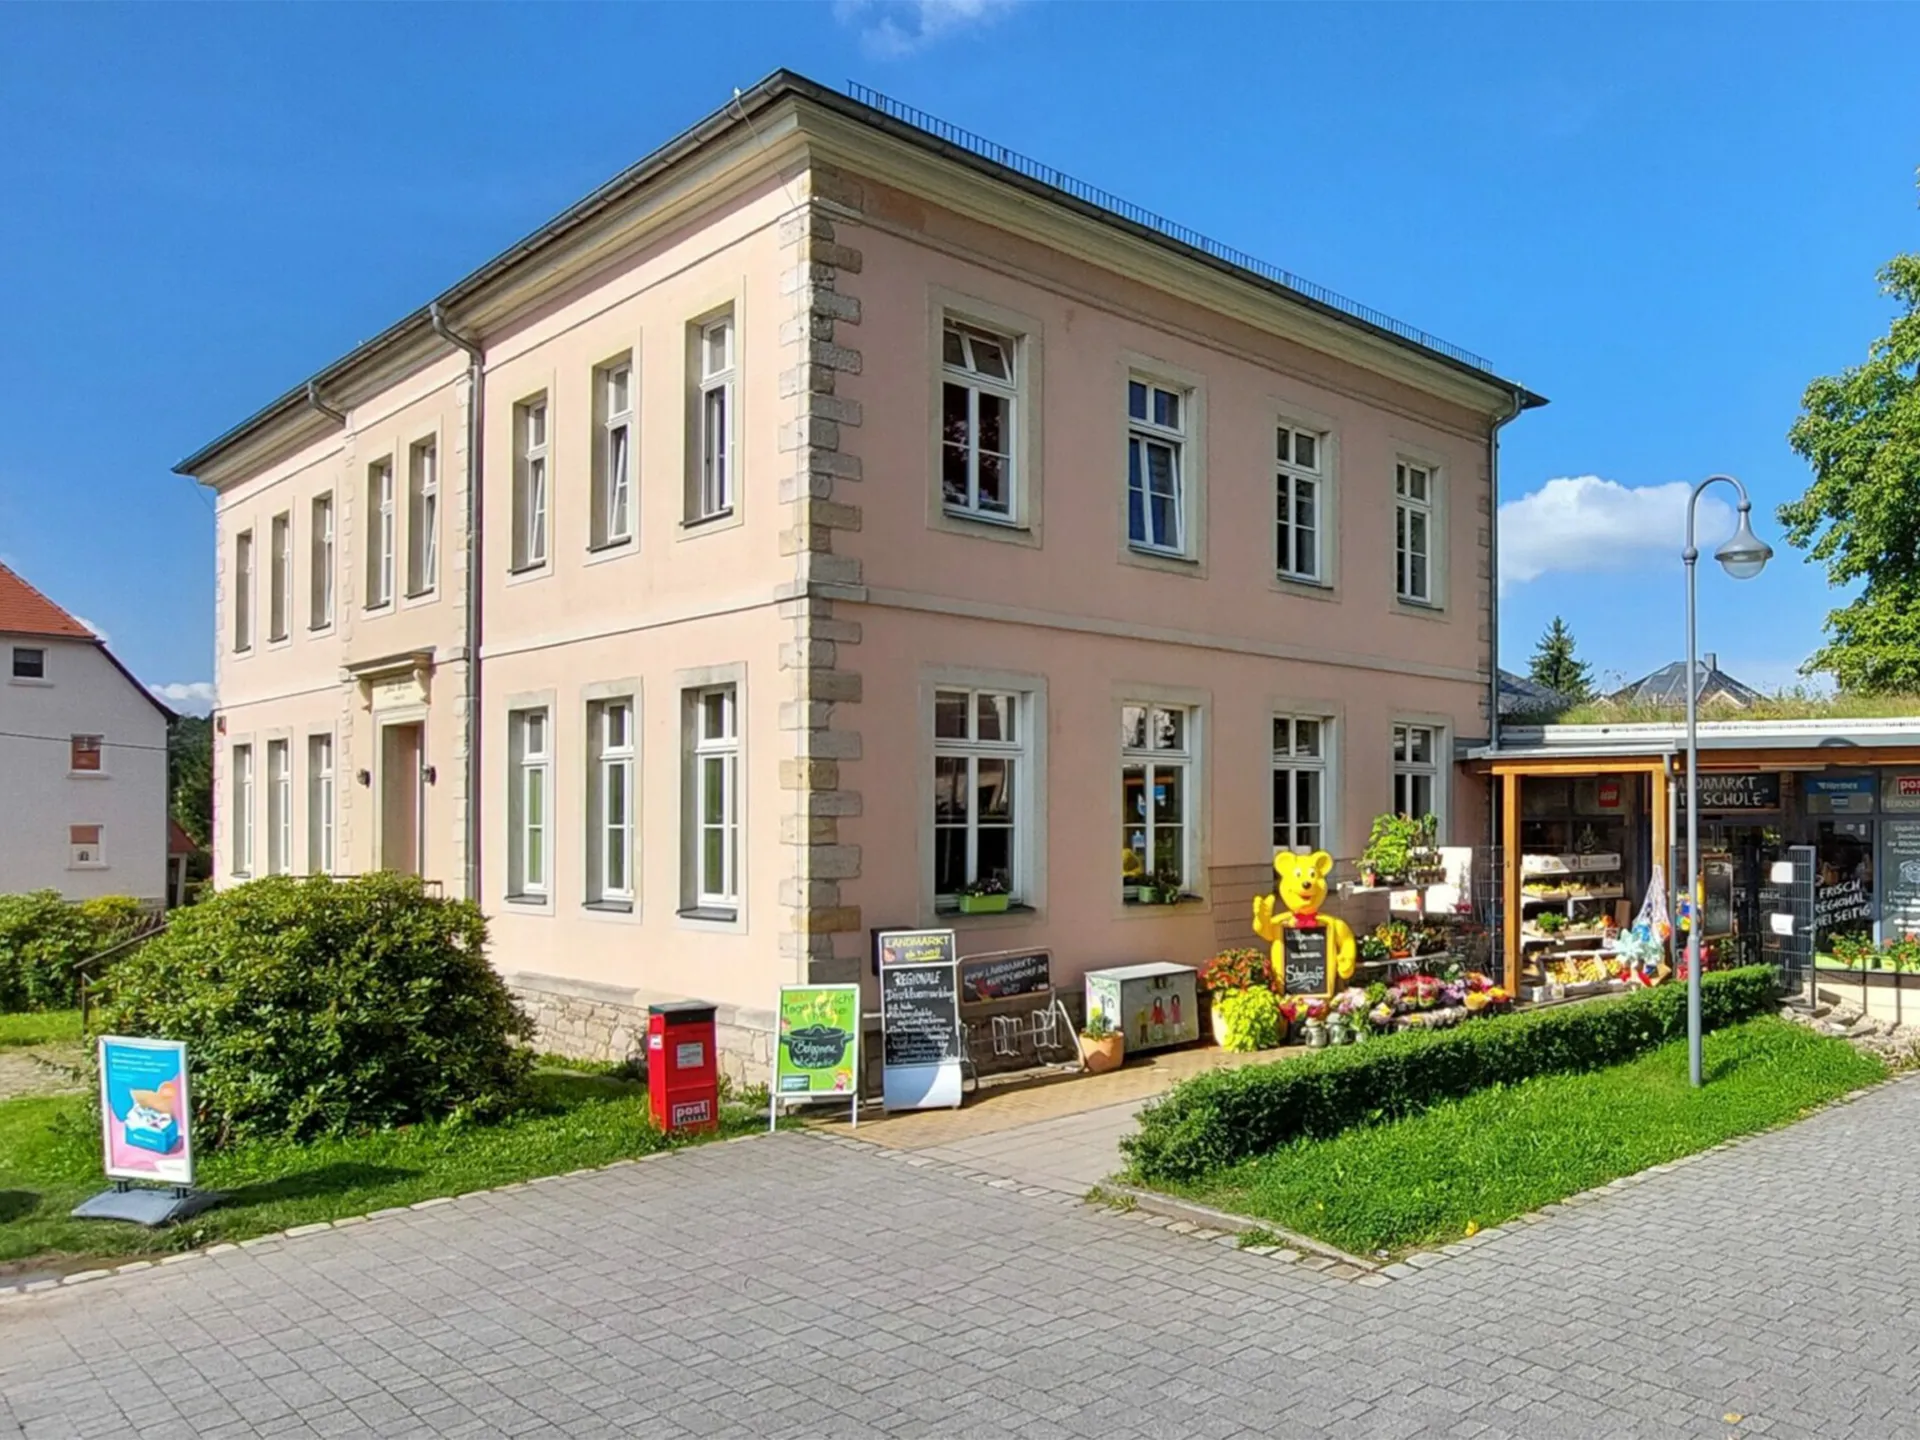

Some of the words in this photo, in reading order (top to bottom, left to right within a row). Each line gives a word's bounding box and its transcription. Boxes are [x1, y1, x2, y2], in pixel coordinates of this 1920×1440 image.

[1819, 879, 1861, 899] FRISCH
[884, 935, 950, 947] LANDMARKT
[892, 970, 942, 986] REGIONALE
